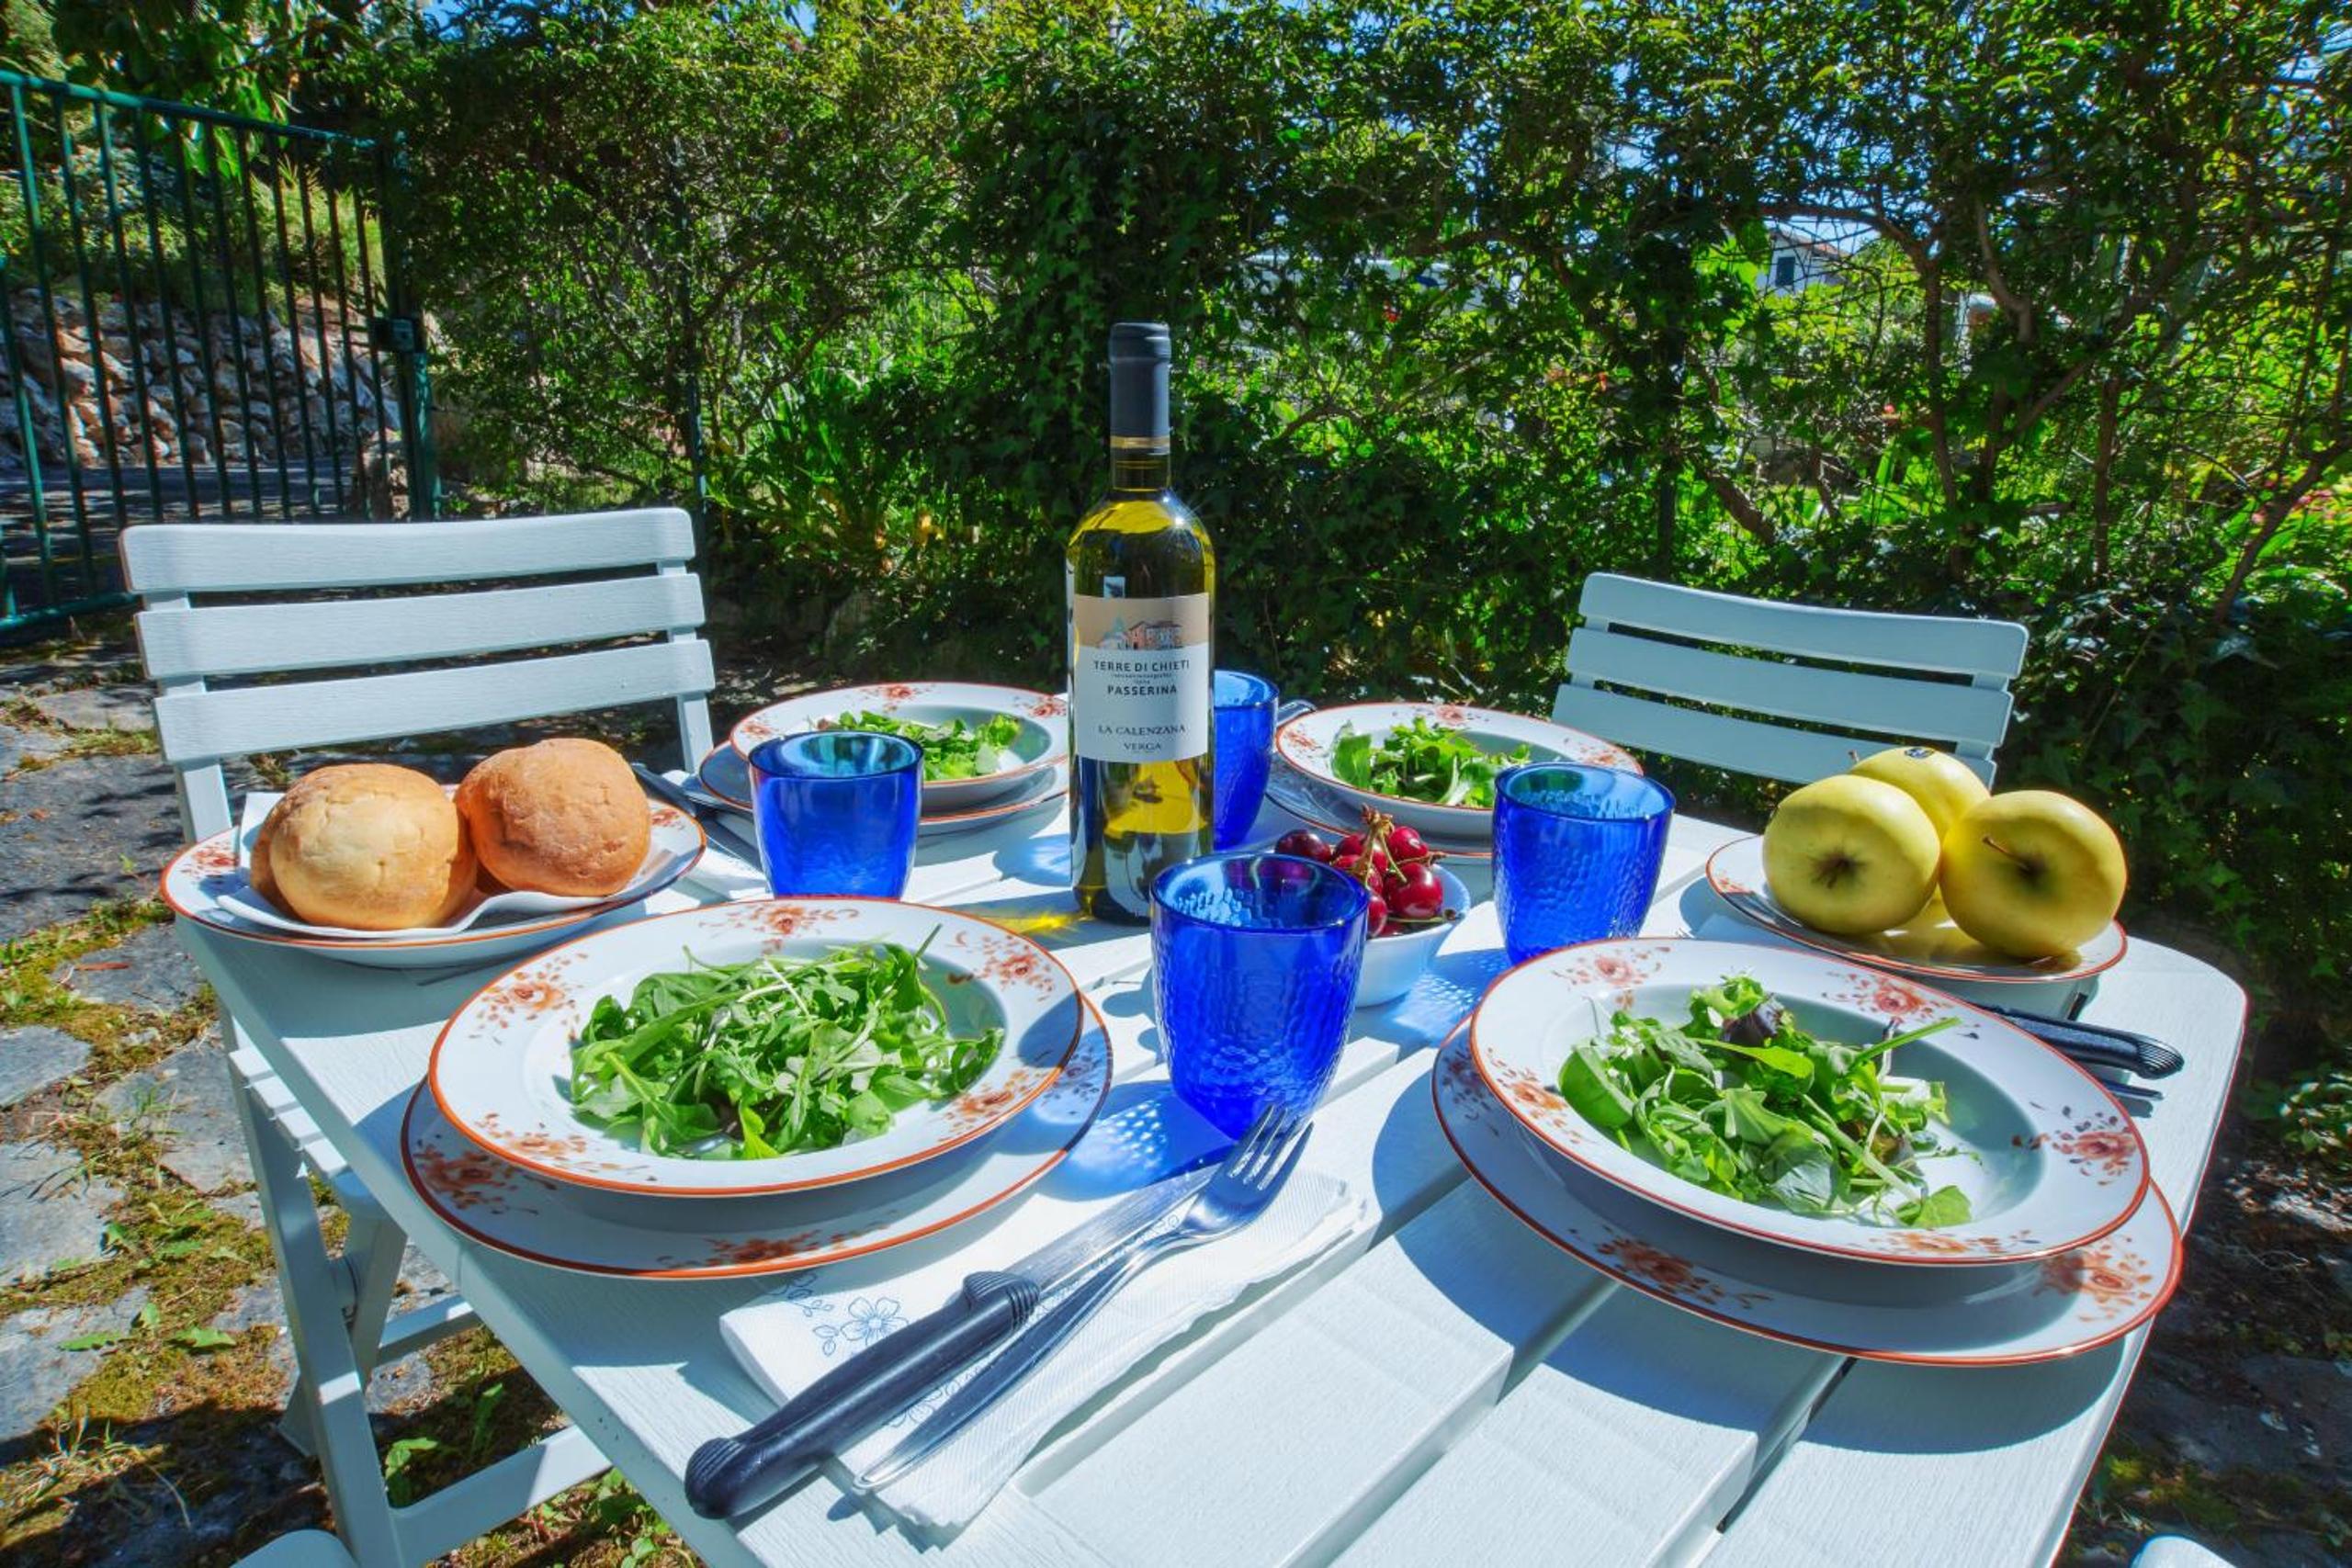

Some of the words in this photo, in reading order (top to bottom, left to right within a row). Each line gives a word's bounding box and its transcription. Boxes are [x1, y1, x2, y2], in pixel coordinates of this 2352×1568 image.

[1093, 660, 1131, 671] TERRE
[1135, 662, 1148, 671] DI
[1152, 660, 1190, 671] CHIETI
[1107, 684, 1177, 695] PASSERINA
[1098, 725, 1113, 734] LA
[1115, 725, 1185, 736] CALENZANA
